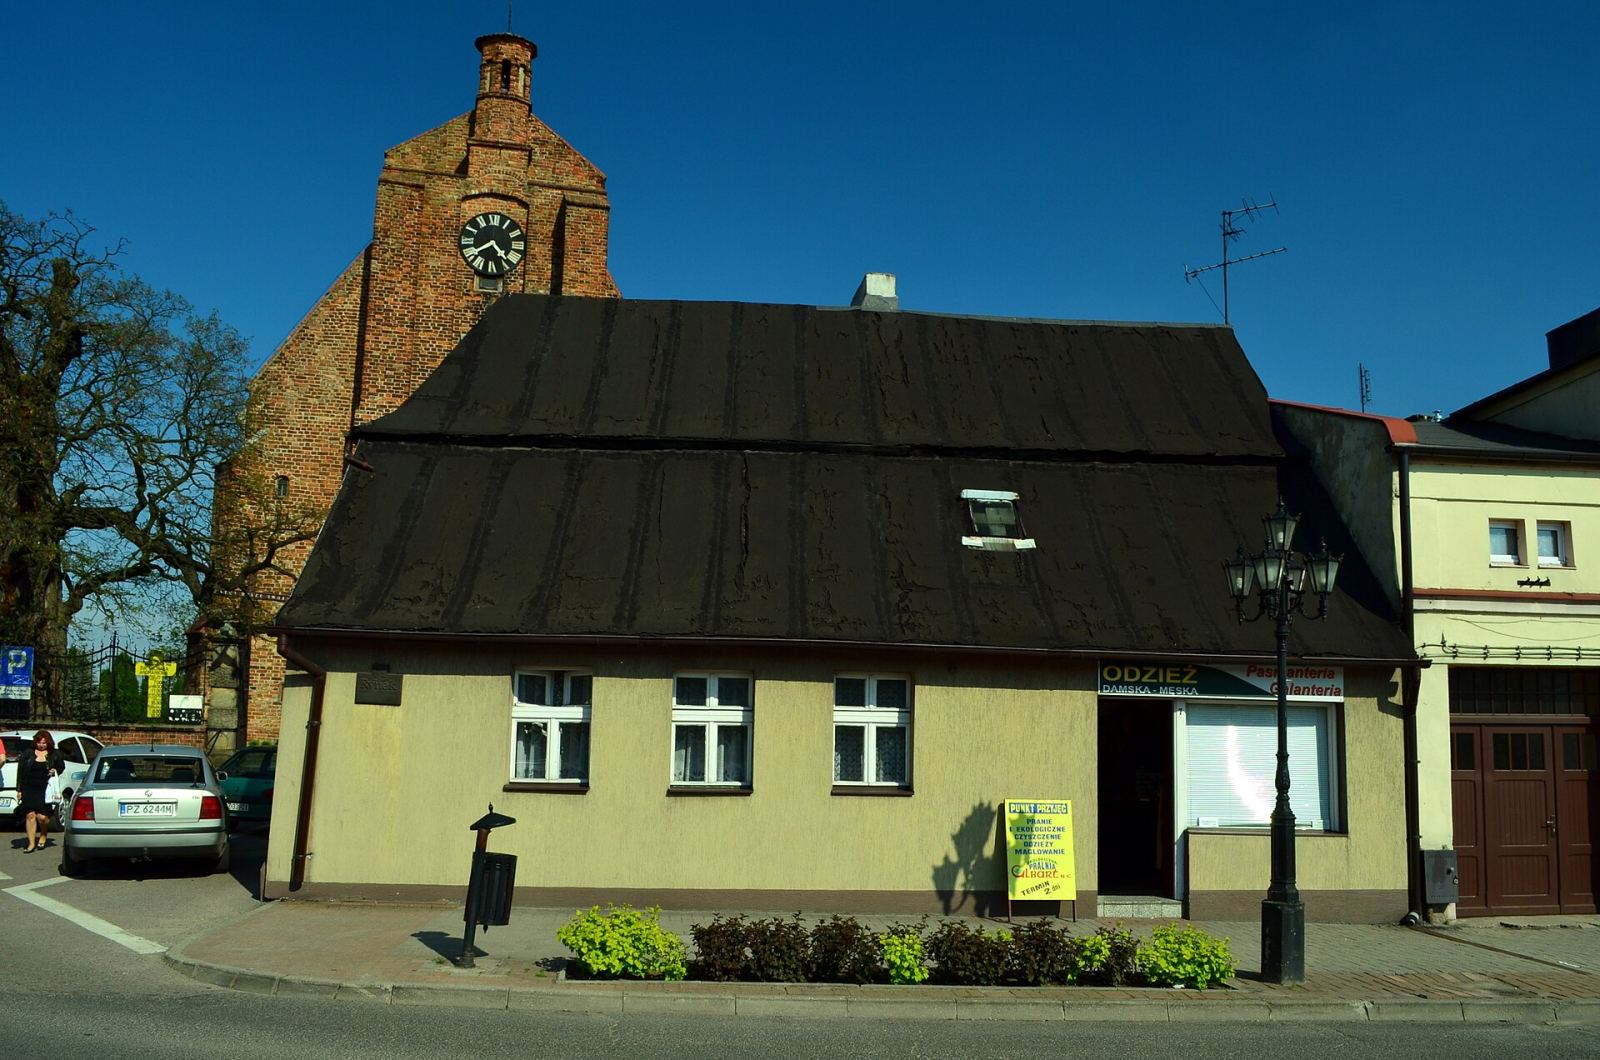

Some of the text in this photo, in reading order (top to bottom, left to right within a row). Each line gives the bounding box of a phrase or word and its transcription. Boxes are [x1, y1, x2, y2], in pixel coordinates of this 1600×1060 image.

[8, 650, 27, 674] P
[1102, 664, 1198, 684] ODZIEŻ
[1102, 684, 1151, 694] DAMSKA
[126, 804, 172, 814] PZ 6244M
[1010, 804, 1035, 813] PUNKT
[1020, 880, 1050, 897] TERMIN
[1044, 888, 1052, 896] 2
